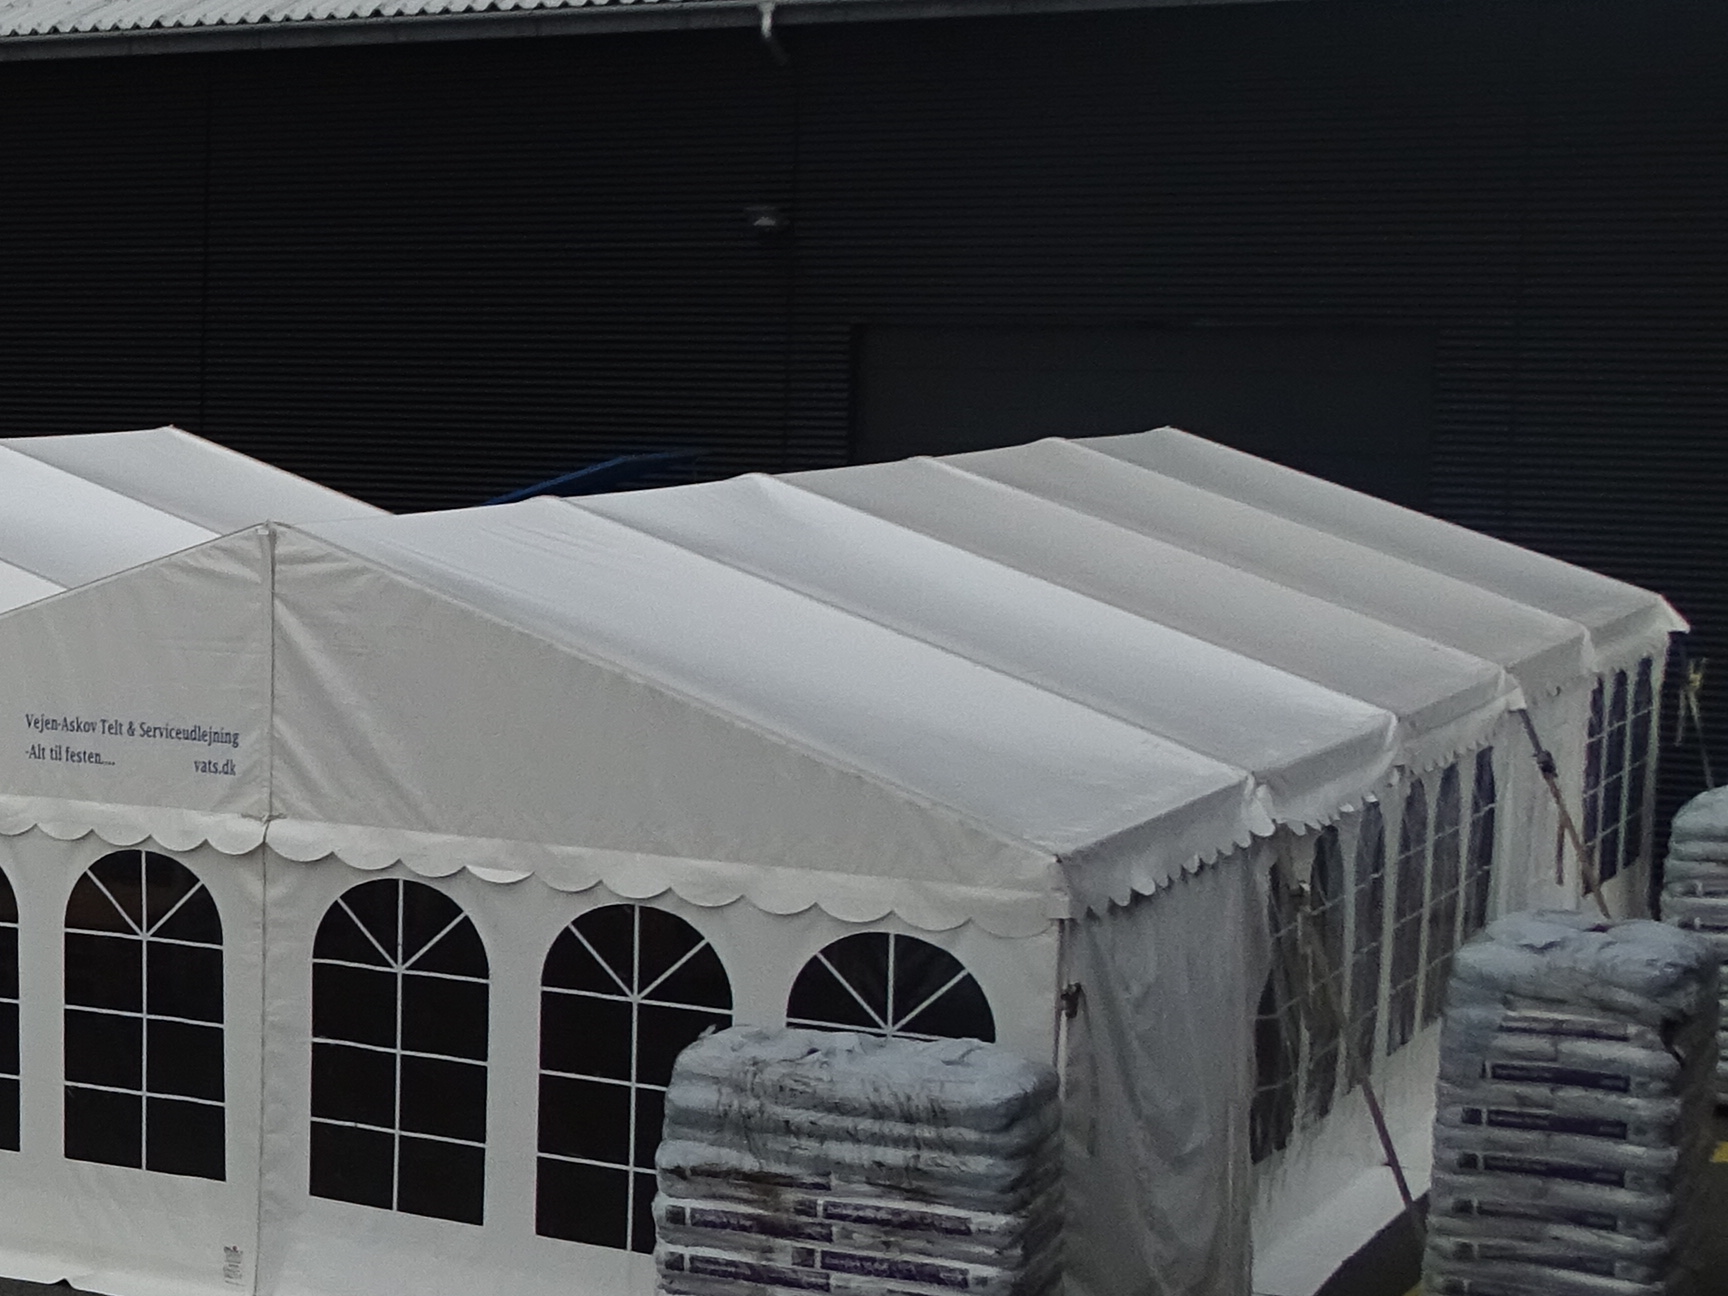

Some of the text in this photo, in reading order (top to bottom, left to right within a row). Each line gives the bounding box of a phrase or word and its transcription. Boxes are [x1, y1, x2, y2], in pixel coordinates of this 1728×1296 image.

[25, 713, 240, 748] Vejen-Askov Telt & Serviceudlejning
[50, 745, 62, 761] til
[194, 759, 236, 776] vats.dk
